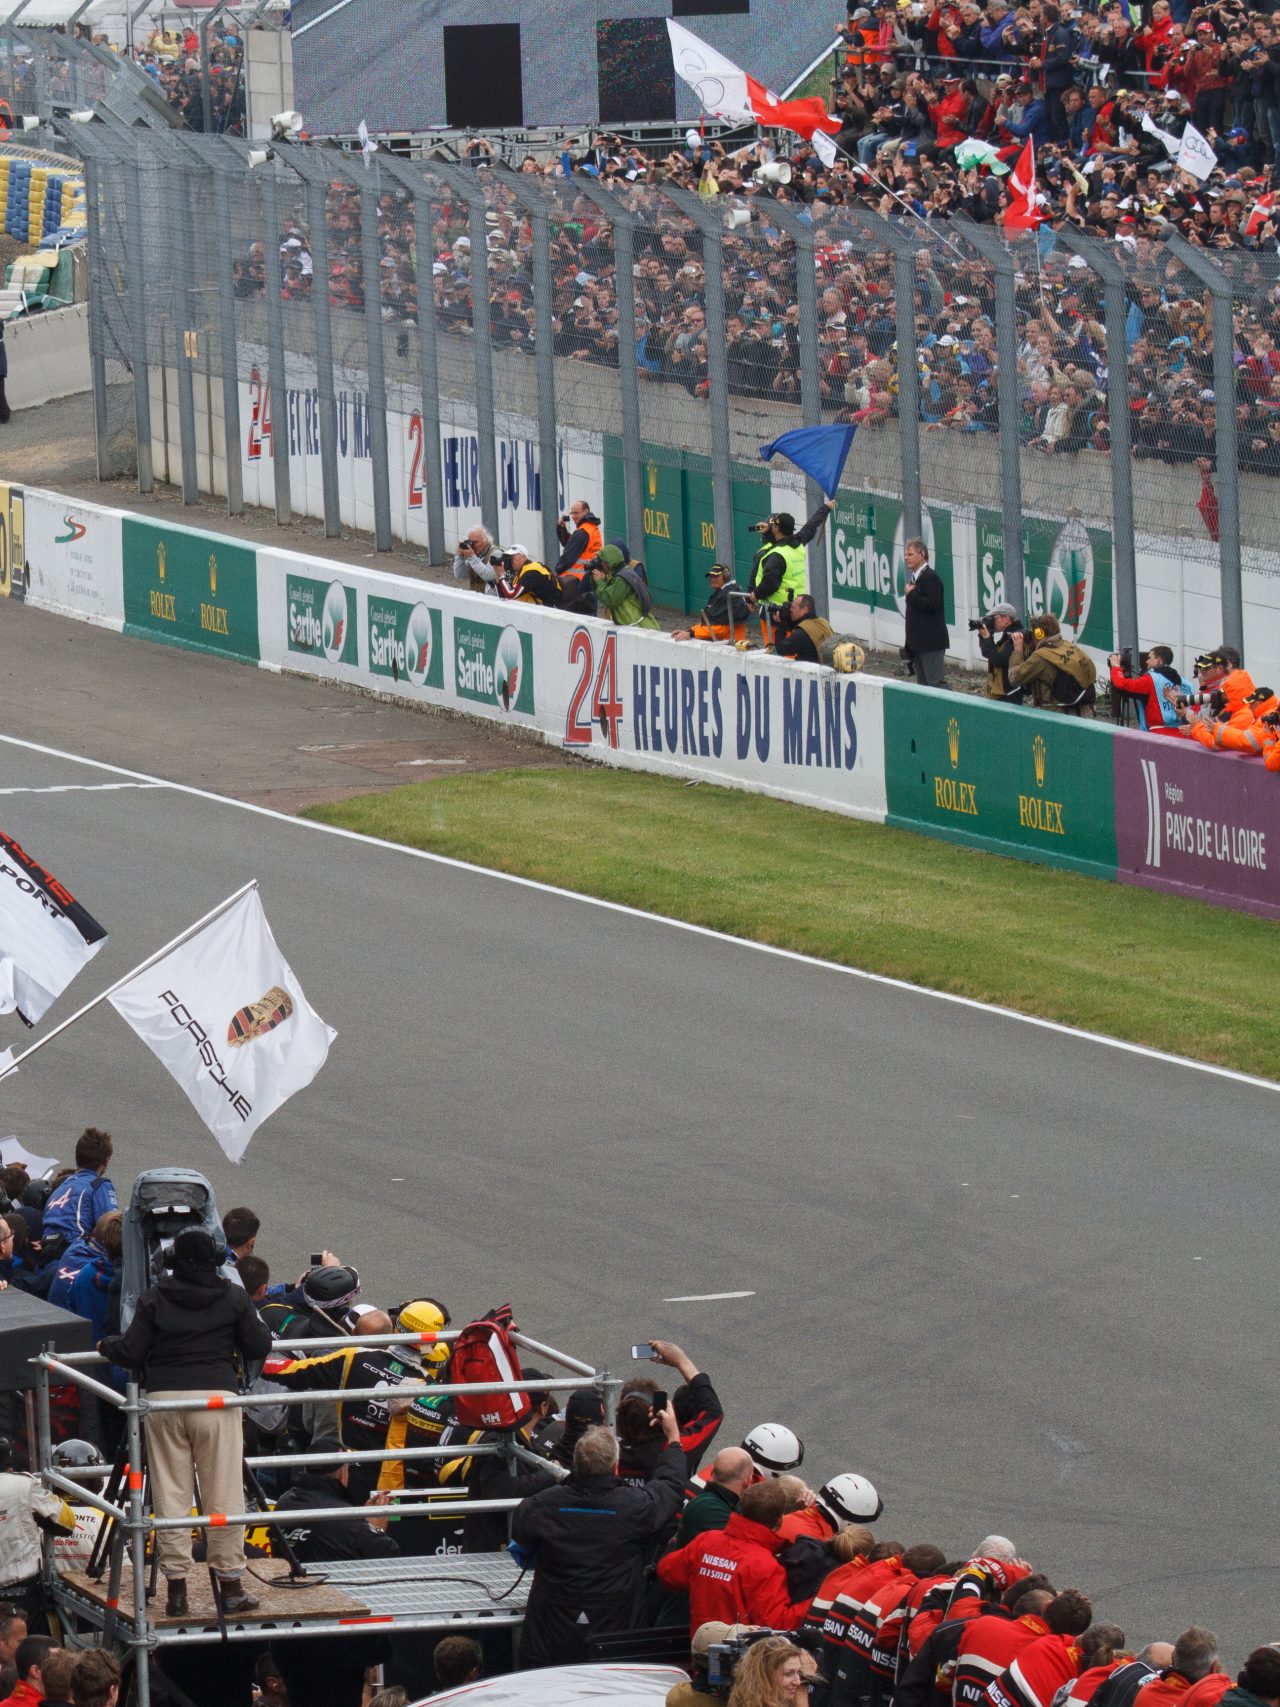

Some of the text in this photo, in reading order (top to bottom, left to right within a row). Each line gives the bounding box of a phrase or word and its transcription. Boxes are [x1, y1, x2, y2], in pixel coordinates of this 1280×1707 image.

[643, 508, 671, 541] OLEX
[150, 591, 177, 622] ROLEX
[200, 603, 229, 636] ROLEX
[290, 602, 322, 649] Sarthe
[371, 624, 405, 671] Sarthe
[457, 649, 494, 697] Sarthe
[563, 625, 858, 771] 24 HEURES DU MANS
[934, 775, 979, 816] ROLEX
[1165, 781, 1184, 803] Région
[1019, 795, 1065, 835] ROLEX
[1166, 811, 1267, 871] PAYS DE LA LOIRE
[158, 990, 252, 1122] PORSCHE
[481, 1412, 500, 1424] HH
[702, 1553, 737, 1571] NISSAN
